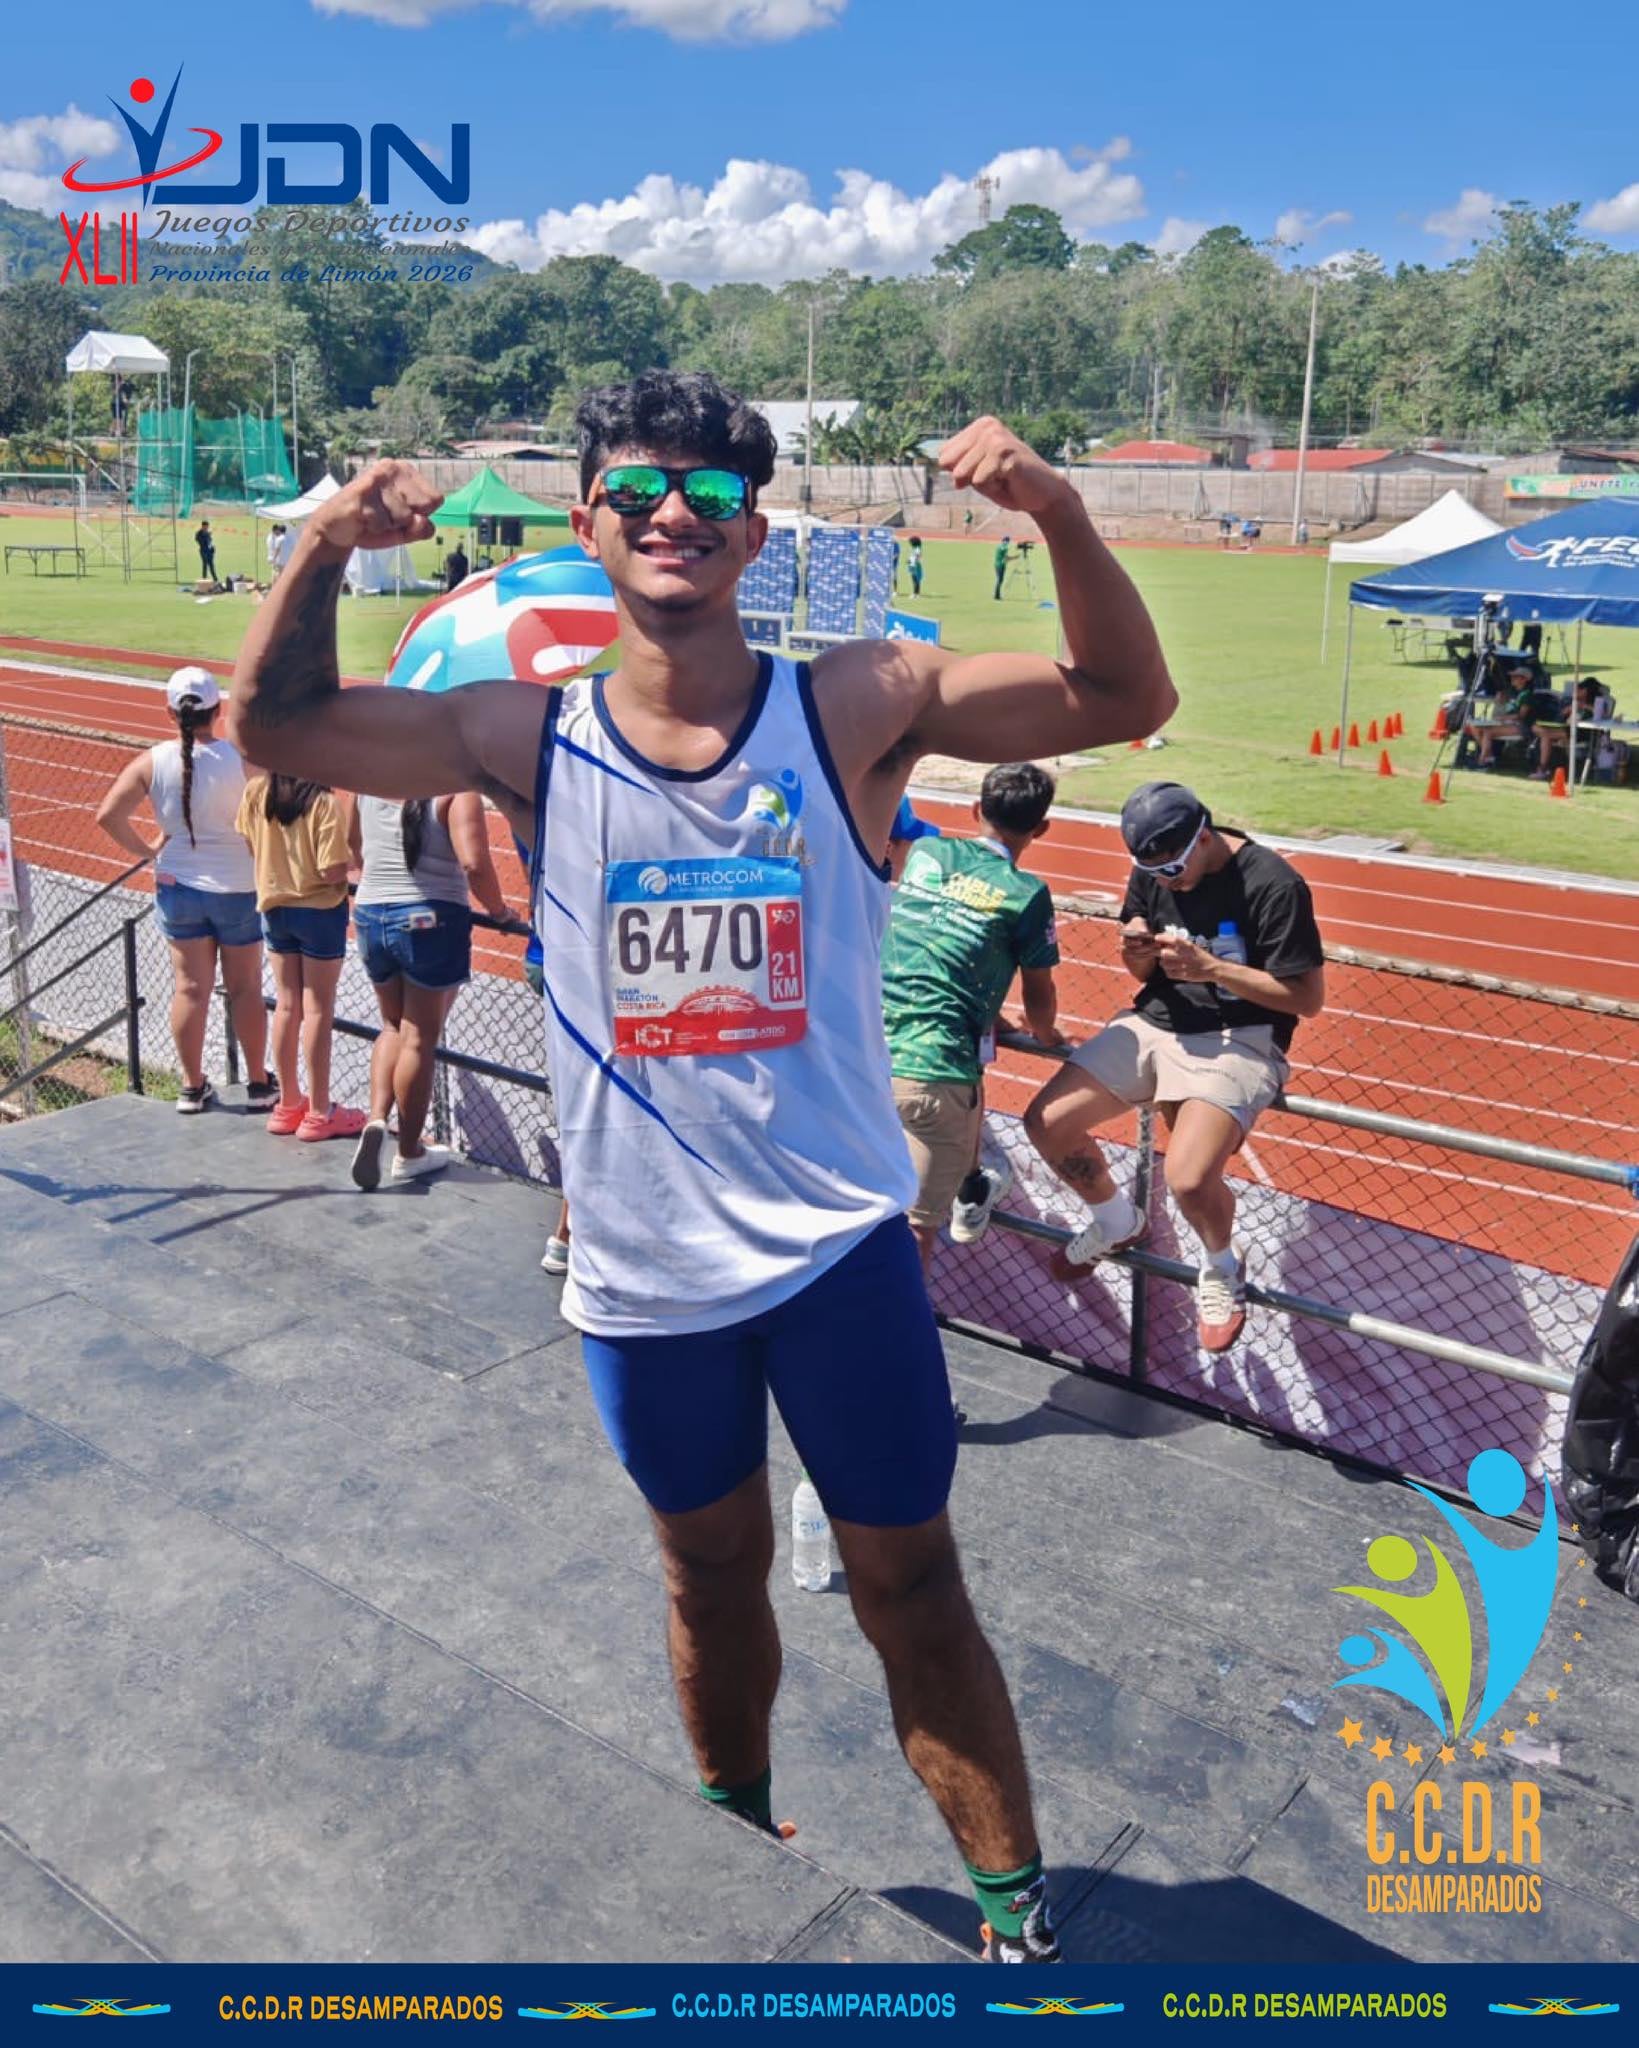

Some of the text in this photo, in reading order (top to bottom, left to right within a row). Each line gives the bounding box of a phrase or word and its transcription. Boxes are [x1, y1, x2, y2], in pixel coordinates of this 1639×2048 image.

[668, 869, 763, 885] METROCOM
[617, 903, 763, 976] 6470
[772, 951, 797, 977] 21
[773, 977, 799, 1000] KM
[646, 1001, 666, 1010] RICA
[635, 1024, 672, 1049] ICT
